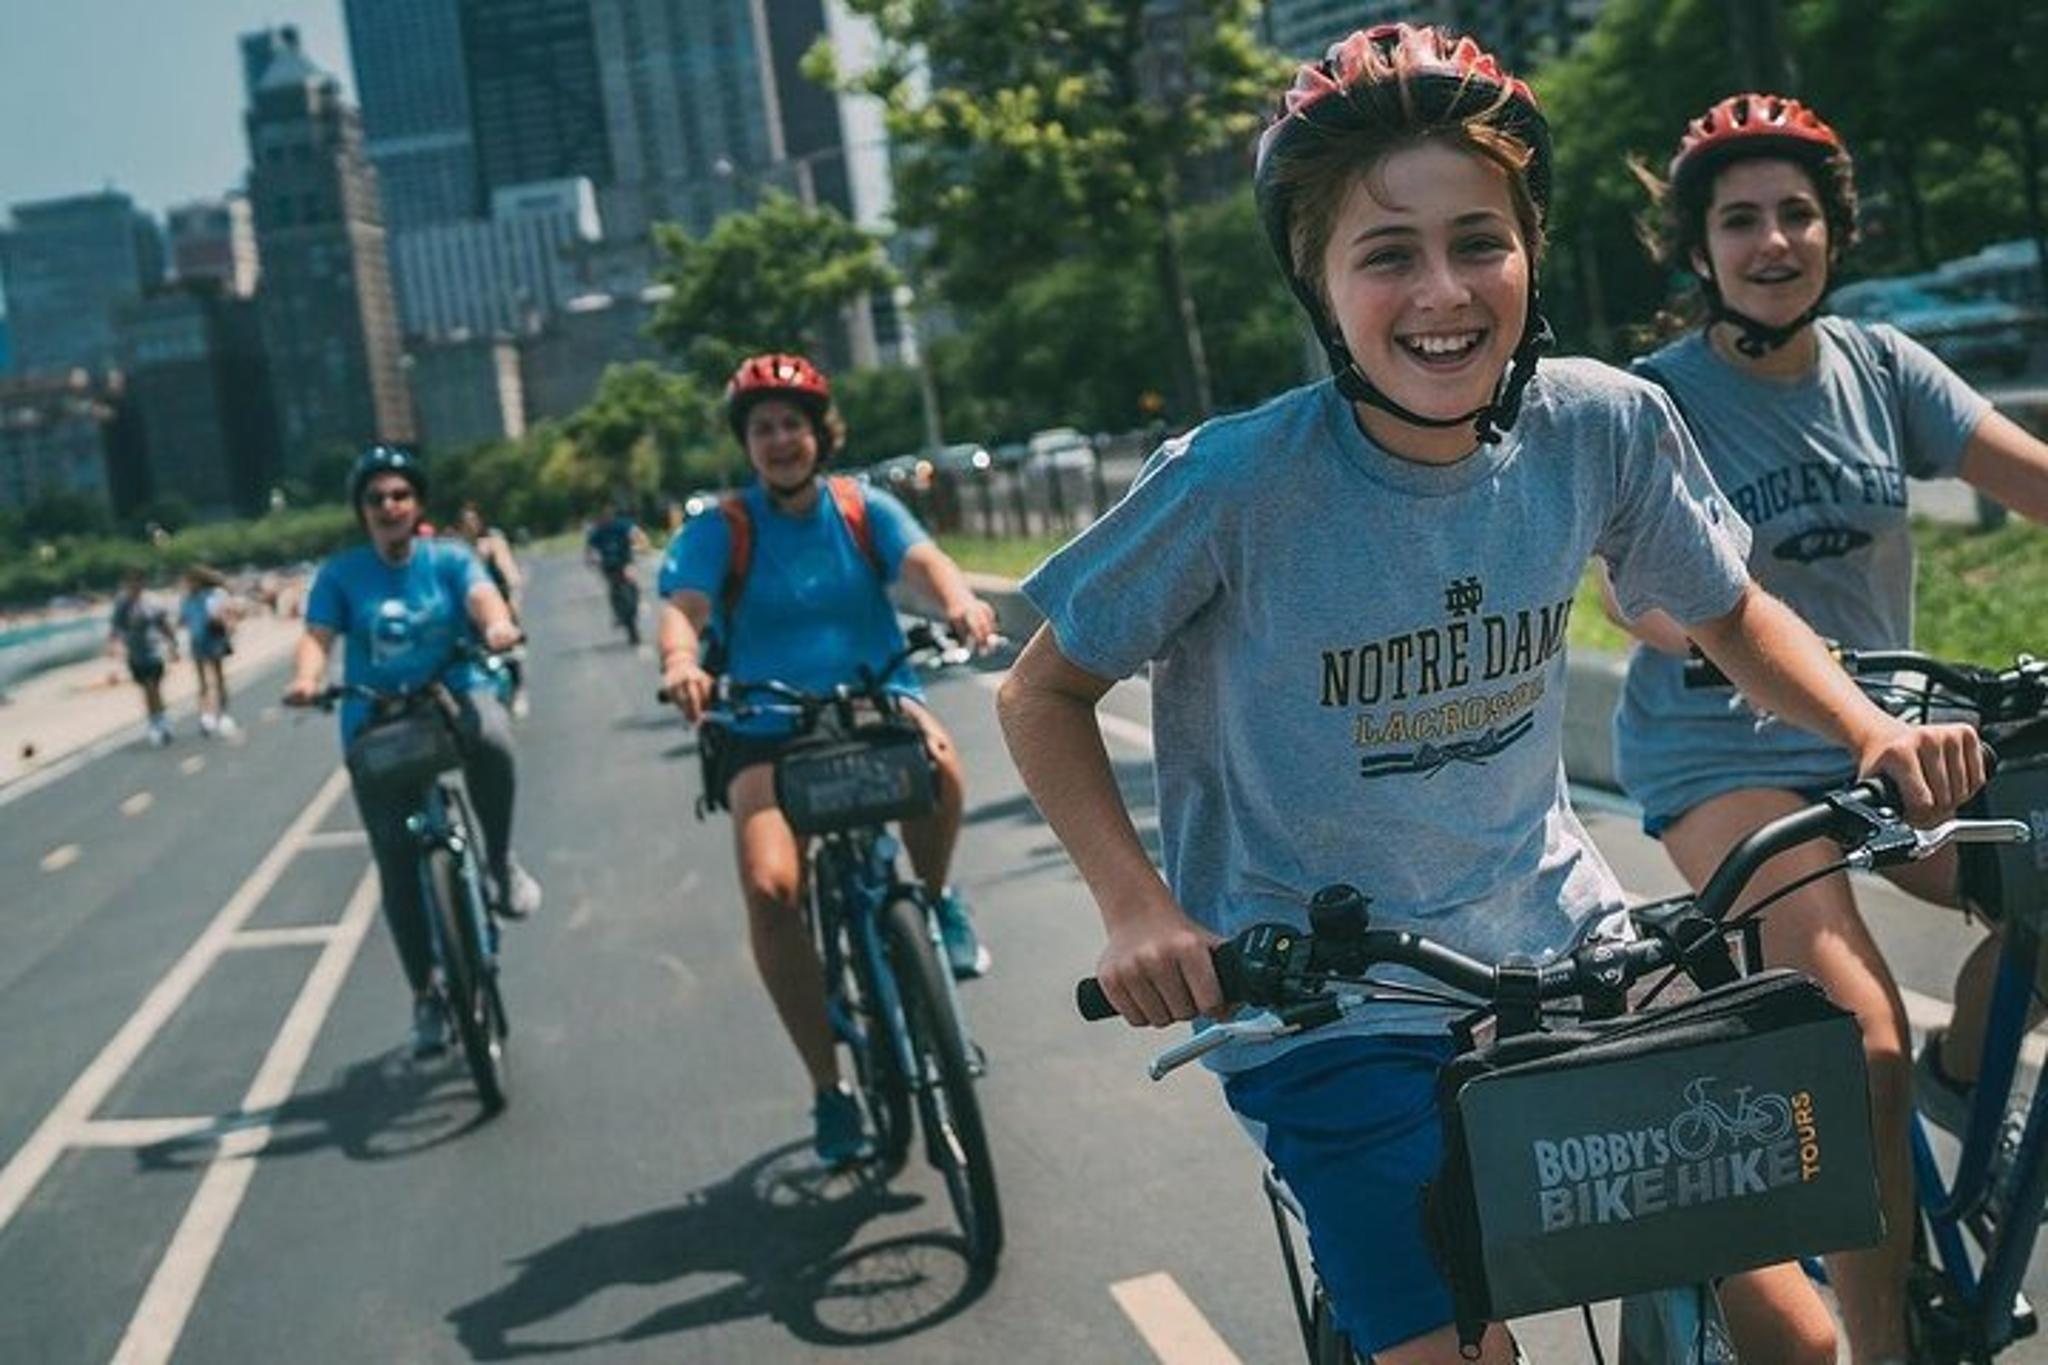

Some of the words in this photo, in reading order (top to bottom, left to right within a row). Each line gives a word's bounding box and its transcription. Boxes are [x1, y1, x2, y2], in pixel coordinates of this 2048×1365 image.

[1725, 464, 1841, 524] RIGLEY
[1322, 623, 1470, 707] NOTRE
[1533, 1127, 1667, 1188] BOBBY'S
[1793, 1091, 1820, 1182] TOURS
[1540, 1167, 1667, 1232] BIKE
[1679, 1139, 1799, 1206] HIKE
